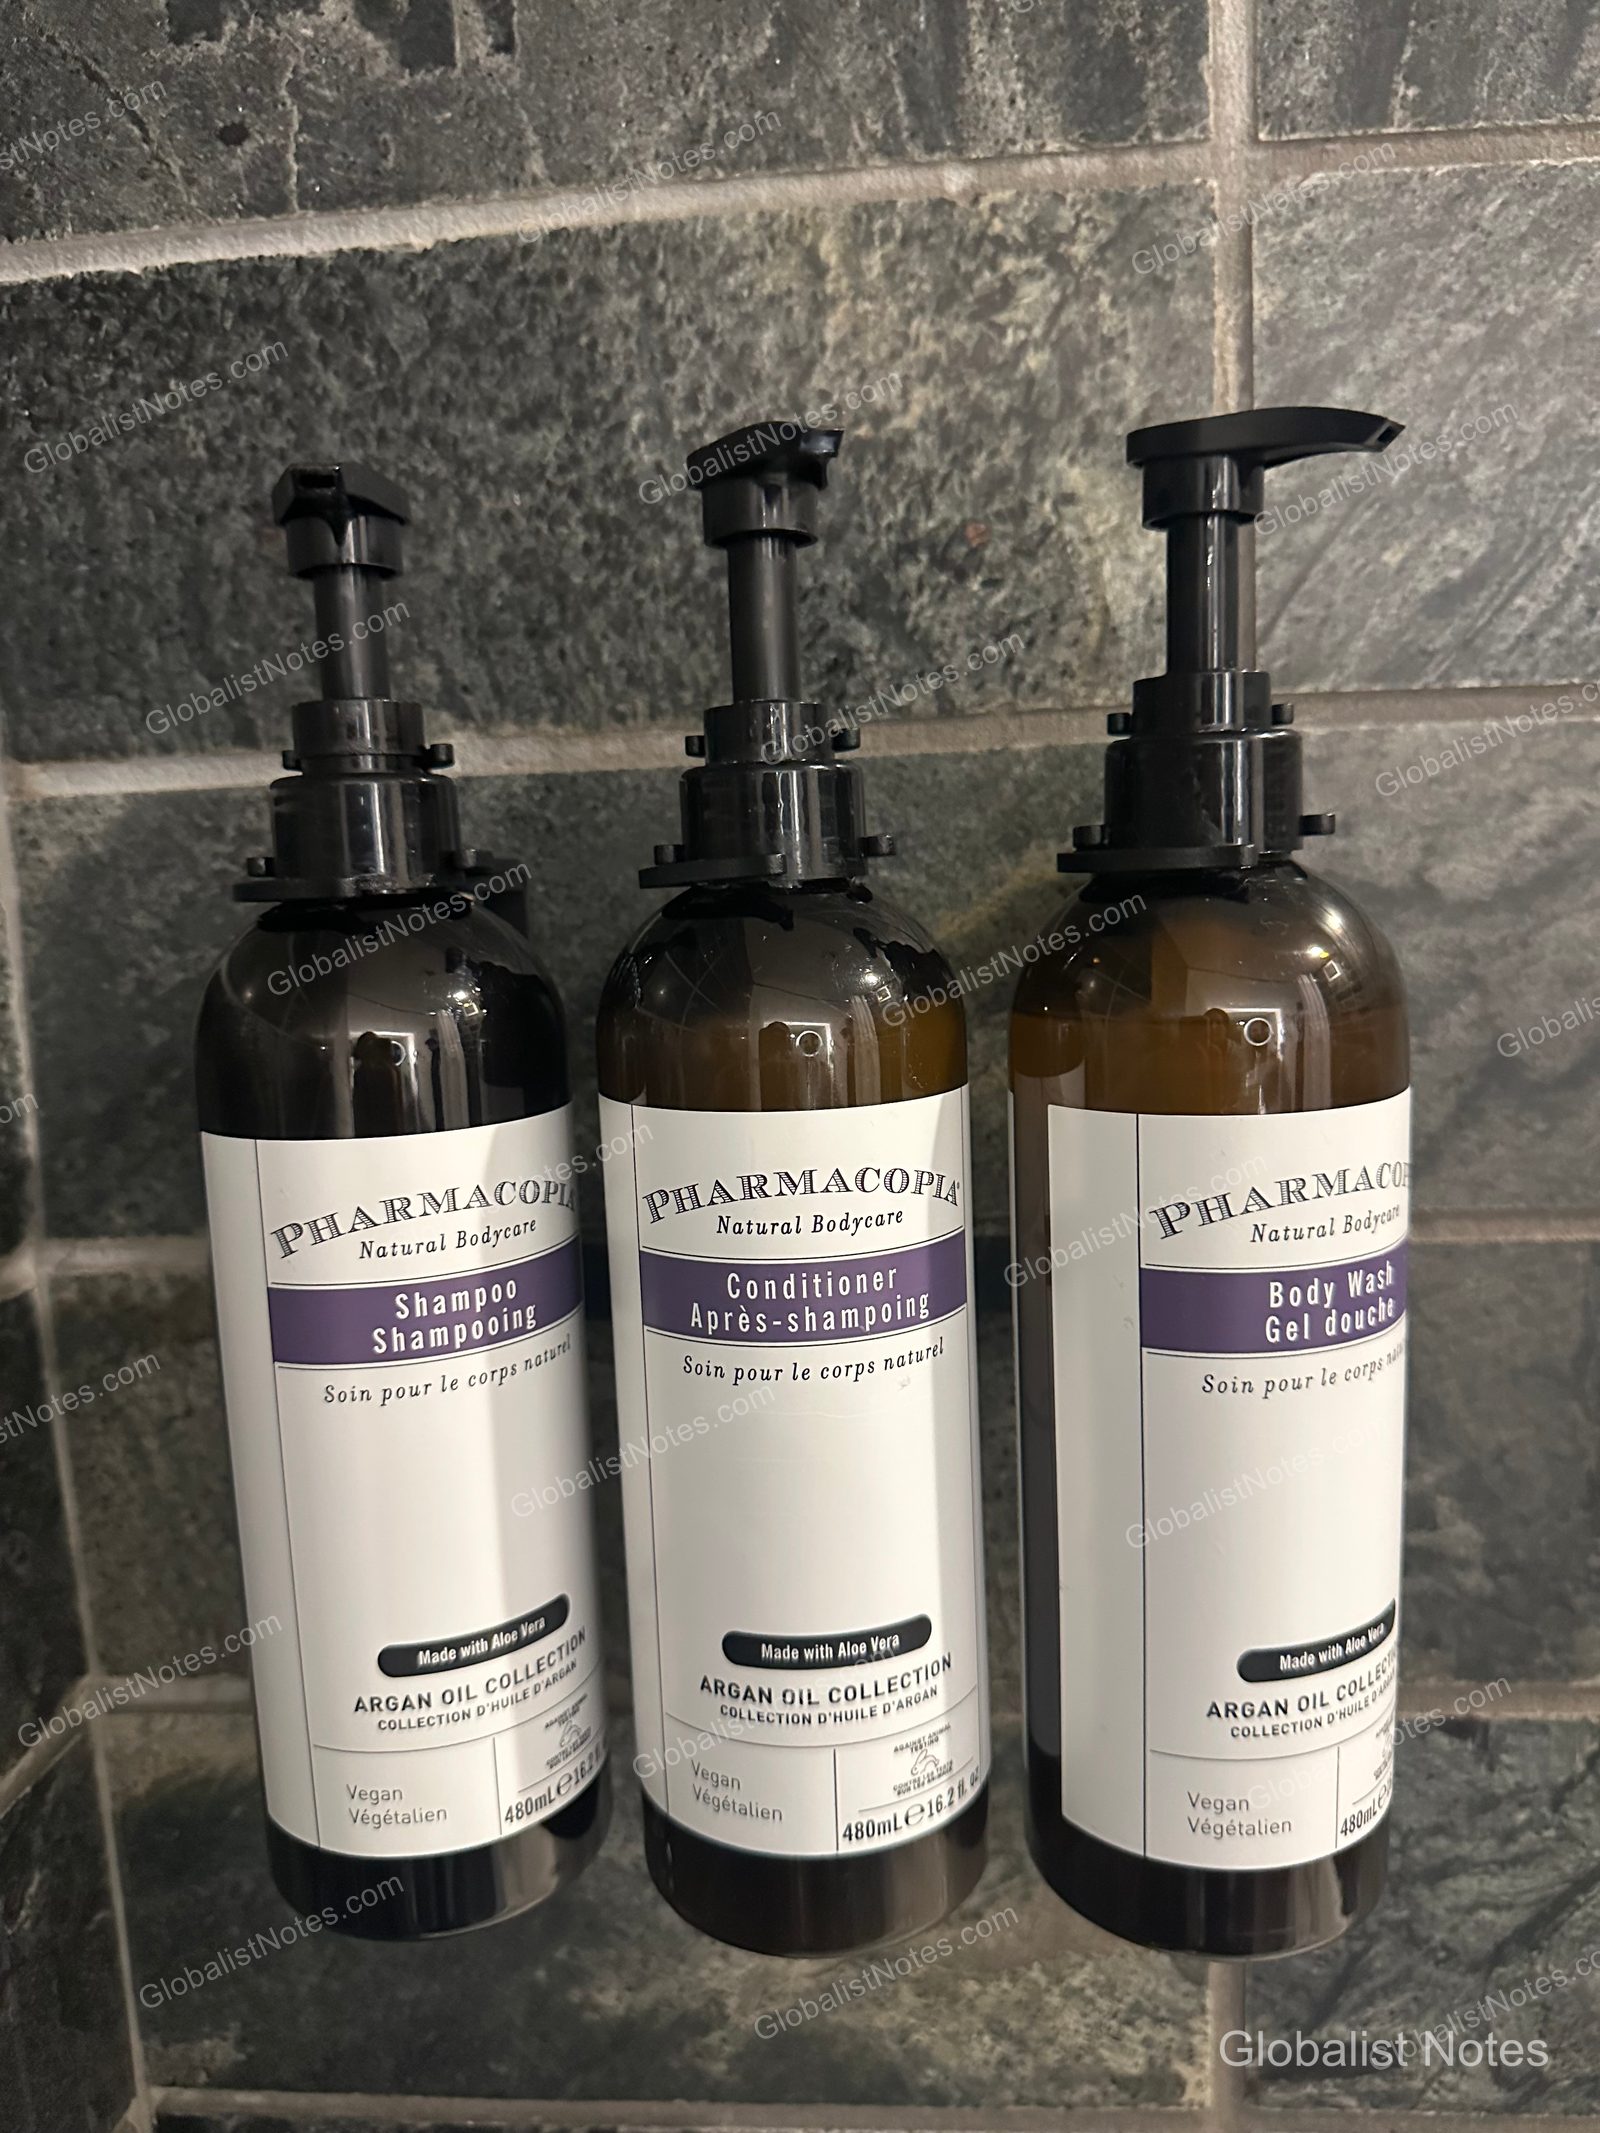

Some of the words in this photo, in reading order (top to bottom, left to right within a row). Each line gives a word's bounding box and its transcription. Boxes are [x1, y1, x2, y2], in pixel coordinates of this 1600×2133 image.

[359, 1233, 447, 1260] Natural
[456, 1218, 537, 1249] Bodycare
[716, 1215, 802, 1235] Natural
[811, 1209, 904, 1237] Bodycare
[1250, 1217, 1335, 1243] Natural
[1343, 1204, 1400, 1235] Bodycare
[395, 1279, 517, 1320] Shampoo
[727, 1266, 898, 1300] Conditioner
[1269, 1277, 1336, 1310] Body
[1348, 1260, 1395, 1298] Wash
[372, 1303, 537, 1355] Shampooing
[690, 1292, 930, 1336] Après-shampoing
[1265, 1313, 1311, 1344] Gel
[1325, 1296, 1396, 1337] douche
[324, 1384, 372, 1404] Soin
[380, 1380, 432, 1406] pour
[441, 1374, 459, 1393] le
[468, 1360, 518, 1387] corps
[524, 1333, 571, 1372] naturel
[683, 1355, 725, 1379] Soin
[732, 1365, 784, 1386] pour
[792, 1362, 811, 1381] le
[820, 1358, 876, 1383] corps
[884, 1336, 945, 1371] naturel
[1201, 1373, 1254, 1394] Soin
[1262, 1374, 1314, 1399] pour
[1321, 1367, 1338, 1387] le
[1344, 1356, 1384, 1381] corps
[418, 1647, 457, 1669] Made
[459, 1637, 489, 1659] with
[491, 1629, 519, 1650] Aloe
[520, 1615, 546, 1638] Vera
[761, 1642, 799, 1661] Made
[803, 1642, 834, 1662] with
[837, 1639, 867, 1659] Aloe
[870, 1632, 900, 1652] Vera
[1279, 1653, 1316, 1673] Made
[1318, 1643, 1343, 1664] with
[1344, 1635, 1367, 1655] Aloe
[354, 1691, 432, 1714] ARGAN
[441, 1683, 479, 1706] OIL
[485, 1625, 588, 1695] COLLECTION
[700, 1674, 773, 1705] ARGAN
[782, 1687, 820, 1706] OIL
[828, 1651, 953, 1704] COLLECTION
[378, 1707, 472, 1732] COLLECTION
[477, 1688, 531, 1718] D'HUILE
[534, 1657, 578, 1697] D'ARGAN
[720, 1704, 812, 1726] COLLECTION
[818, 1704, 878, 1725] D'HUILE
[882, 1684, 939, 1715] D'ARGAN
[1206, 1697, 1290, 1720] ARGAN
[1297, 1690, 1330, 1713] OIL
[1230, 1715, 1323, 1739] COLLECTION
[1327, 1693, 1370, 1726] D'HUILE
[346, 1783, 403, 1806] Vegan
[691, 1759, 742, 1790] Vegan
[348, 1806, 447, 1829] Végétalien
[504, 1784, 556, 1823] 480mL
[692, 1783, 783, 1823] Végétalien
[842, 1812, 903, 1841] 480mL
[927, 1786, 955, 1818] 16.2
[1187, 1791, 1249, 1815] Vegan
[1340, 1797, 1378, 1836] 480mL
[1187, 1816, 1292, 1840] Végétalien
